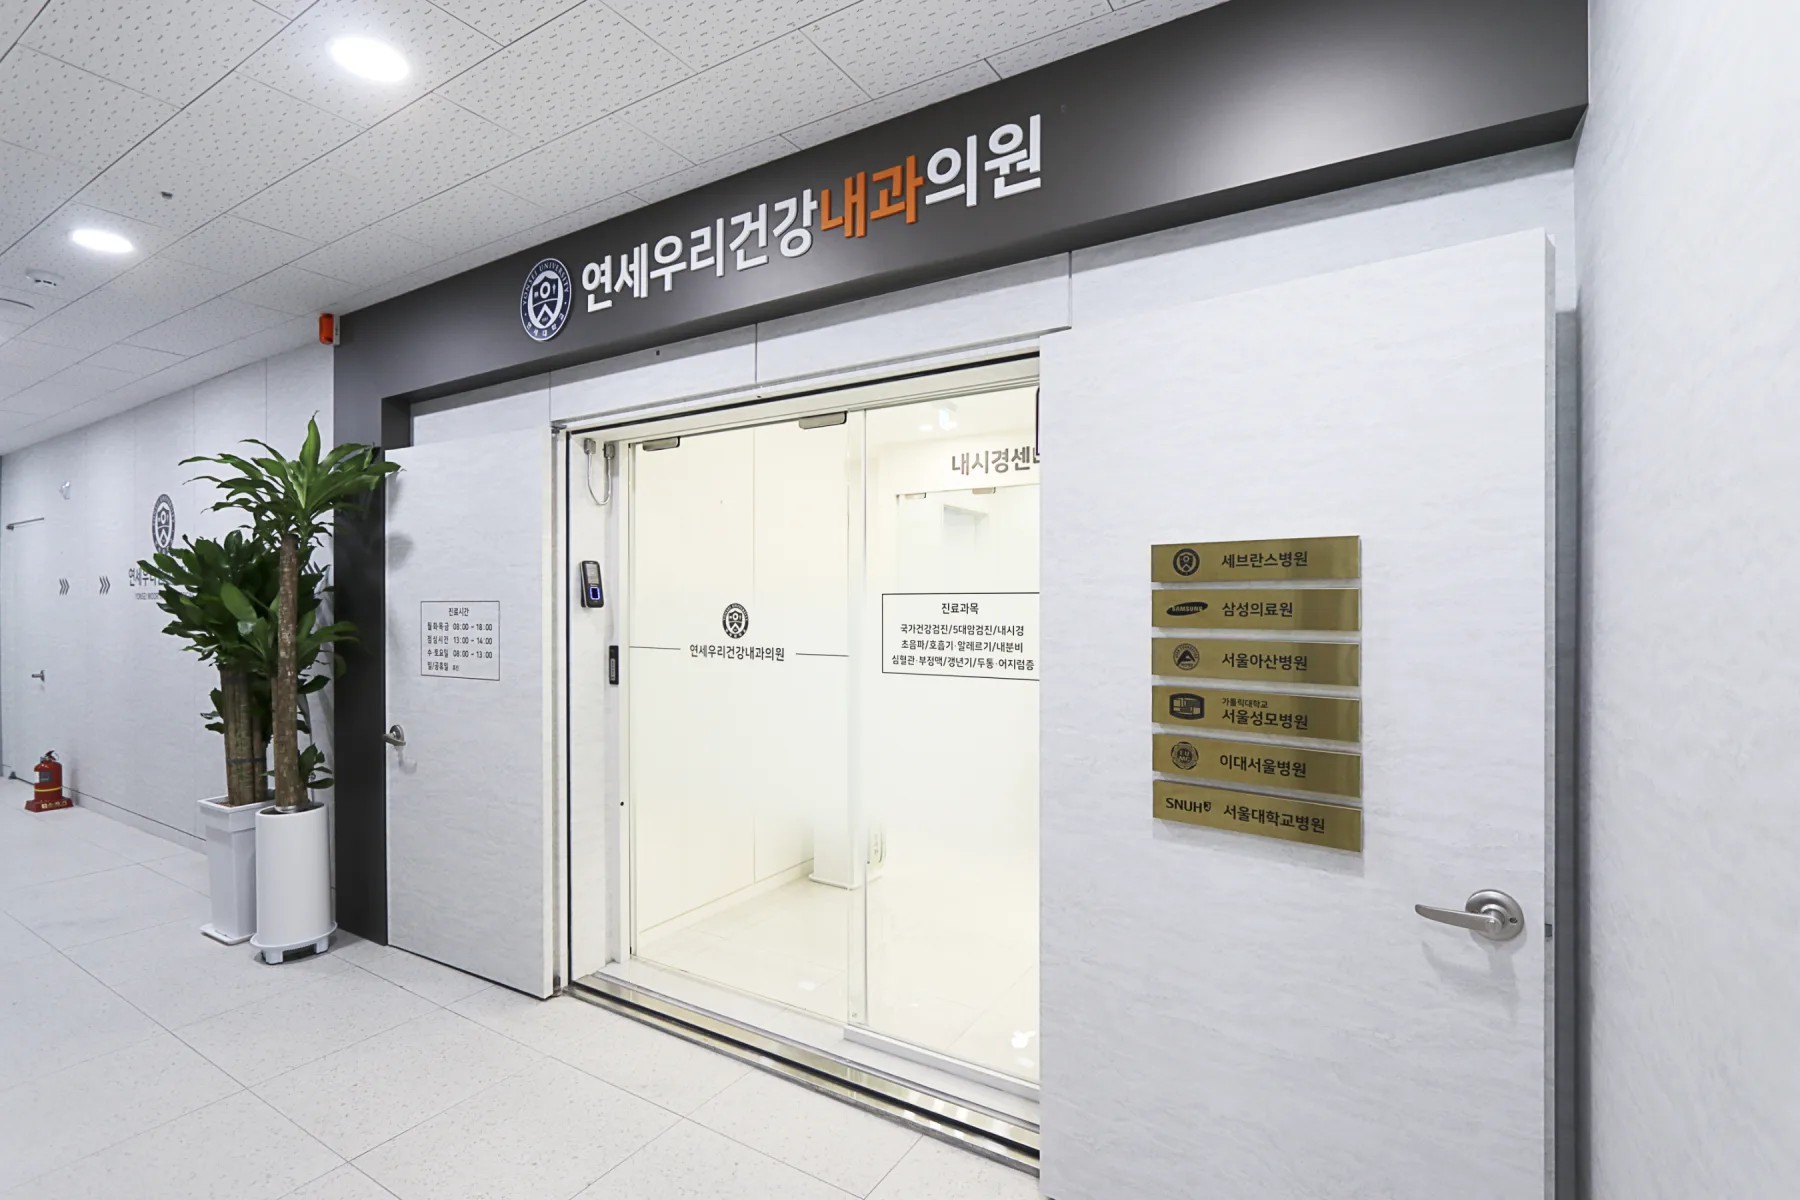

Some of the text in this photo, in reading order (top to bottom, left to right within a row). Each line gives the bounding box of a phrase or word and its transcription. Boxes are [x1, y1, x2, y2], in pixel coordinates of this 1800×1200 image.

[582, 114, 1042, 313] 연세우리건강내과의원
[1221, 551, 1308, 568] 세브란스병원
[448, 607, 470, 617] 진료시간
[941, 602, 979, 615] 진료과목
[1222, 602, 1293, 618] 삼성의료원
[689, 644, 785, 662] 연세우리건강내과의원
[1221, 652, 1308, 671] 서울아산병원
[1221, 708, 1309, 731] 서울성모병원
[1219, 753, 1307, 778] 이대서울병원
[1165, 797, 1203, 813] SNUH
[1223, 804, 1325, 834] 서울대학교병원
